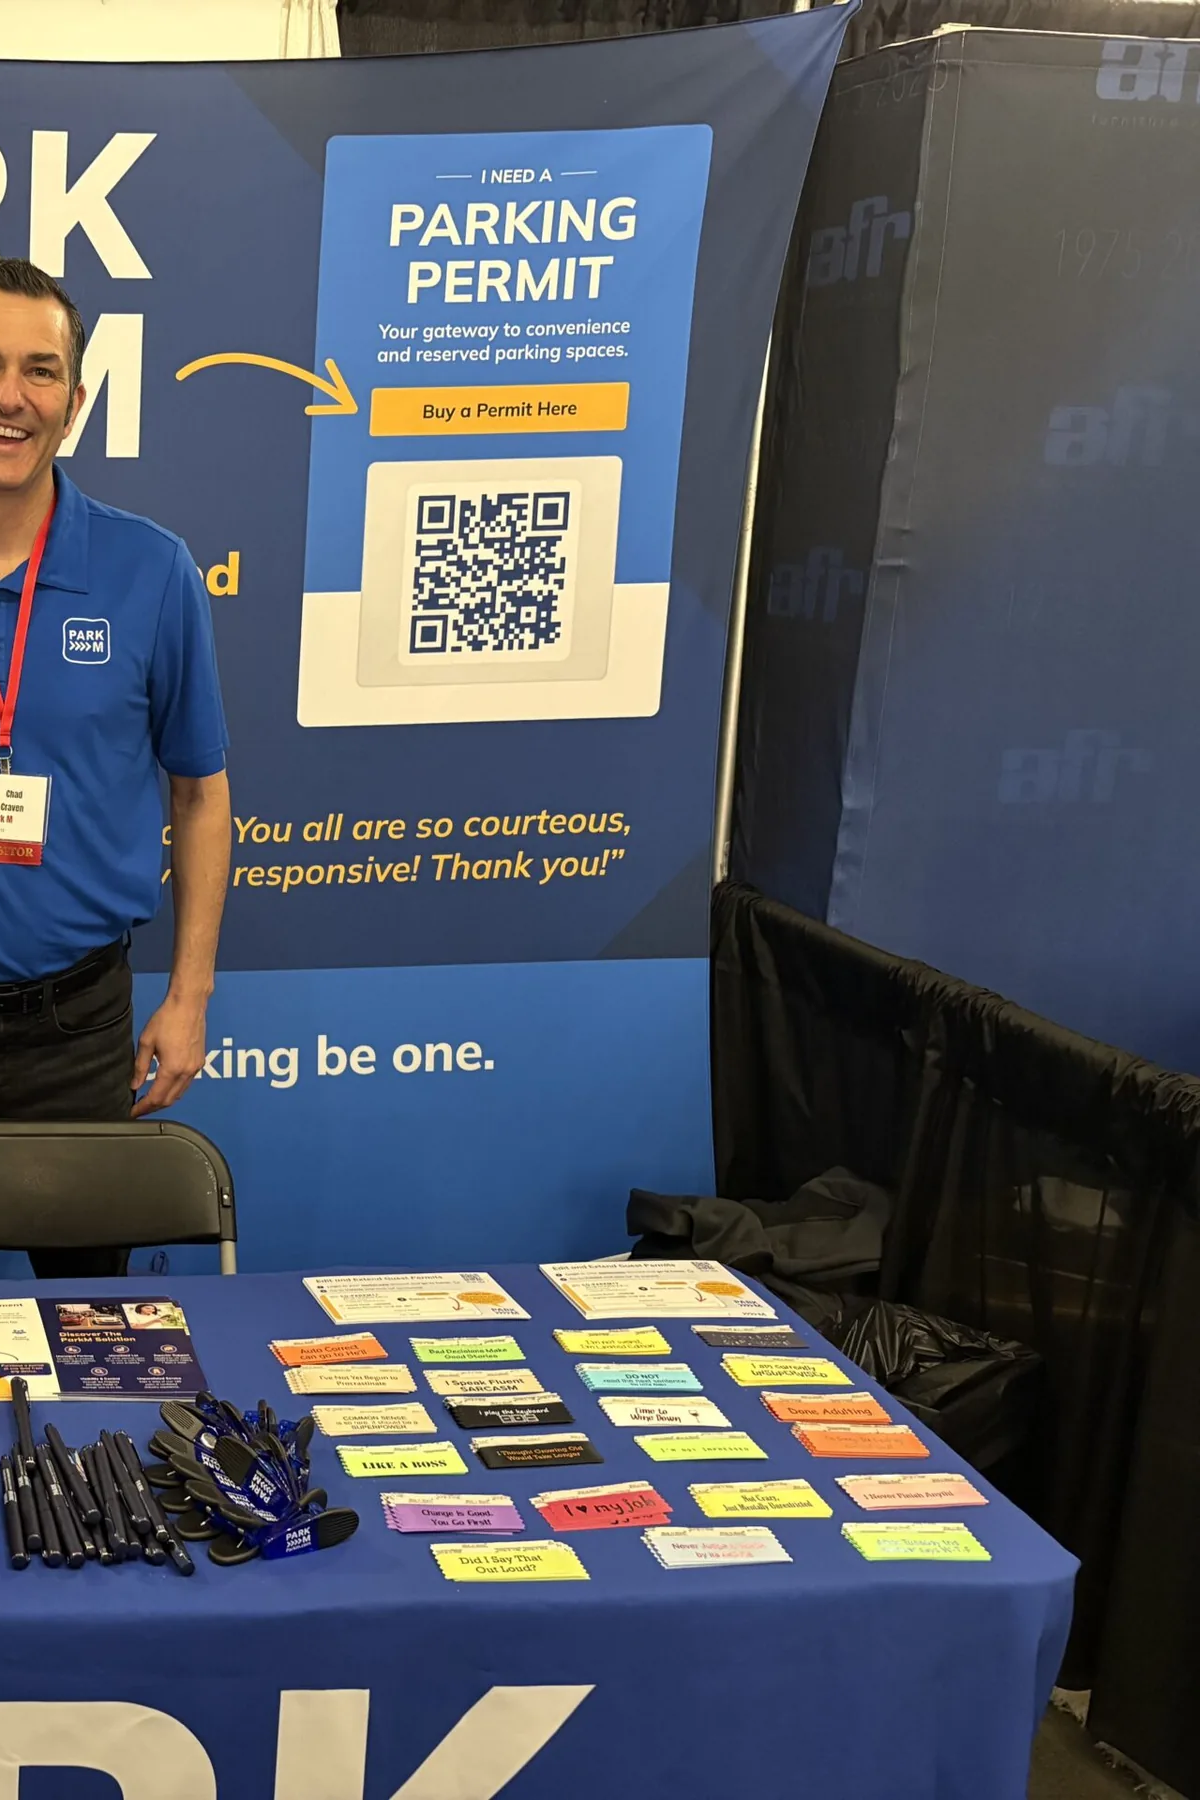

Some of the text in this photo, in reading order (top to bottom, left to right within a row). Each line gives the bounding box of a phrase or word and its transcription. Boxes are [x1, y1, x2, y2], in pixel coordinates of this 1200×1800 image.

[481, 168, 553, 184] I NEED A
[389, 196, 637, 247] PARKING
[407, 255, 614, 304] PERMIT
[378, 318, 631, 343] Your gateway to convenience
[377, 343, 629, 365] and reserved parking spaces.
[422, 401, 578, 423] Buy a Permit Here
[69, 630, 104, 640] PARK
[93, 642, 103, 652] M
[6, 790, 23, 799] Chad
[1, 803, 24, 812] Craven
[6, 815, 12, 823] M
[233, 809, 631, 844] You all are so courteous,
[232, 854, 422, 893] responsive!
[431, 850, 534, 881] Thank
[317, 1034, 376, 1076] be
[392, 1041, 495, 1074] one.
[300, 1344, 359, 1354] Auto Correct
[788, 1407, 873, 1416] Done Adulting
[362, 1460, 448, 1470] LIKE A BOSS
[421, 1510, 454, 1518] Change
[595, 1502, 624, 1516] my
[431, 1519, 449, 1527] You
[286, 1527, 311, 1541] PARK
[460, 1557, 482, 1565] Did
[493, 1556, 512, 1565] Say
[475, 1565, 537, 1573] Out Loud?
